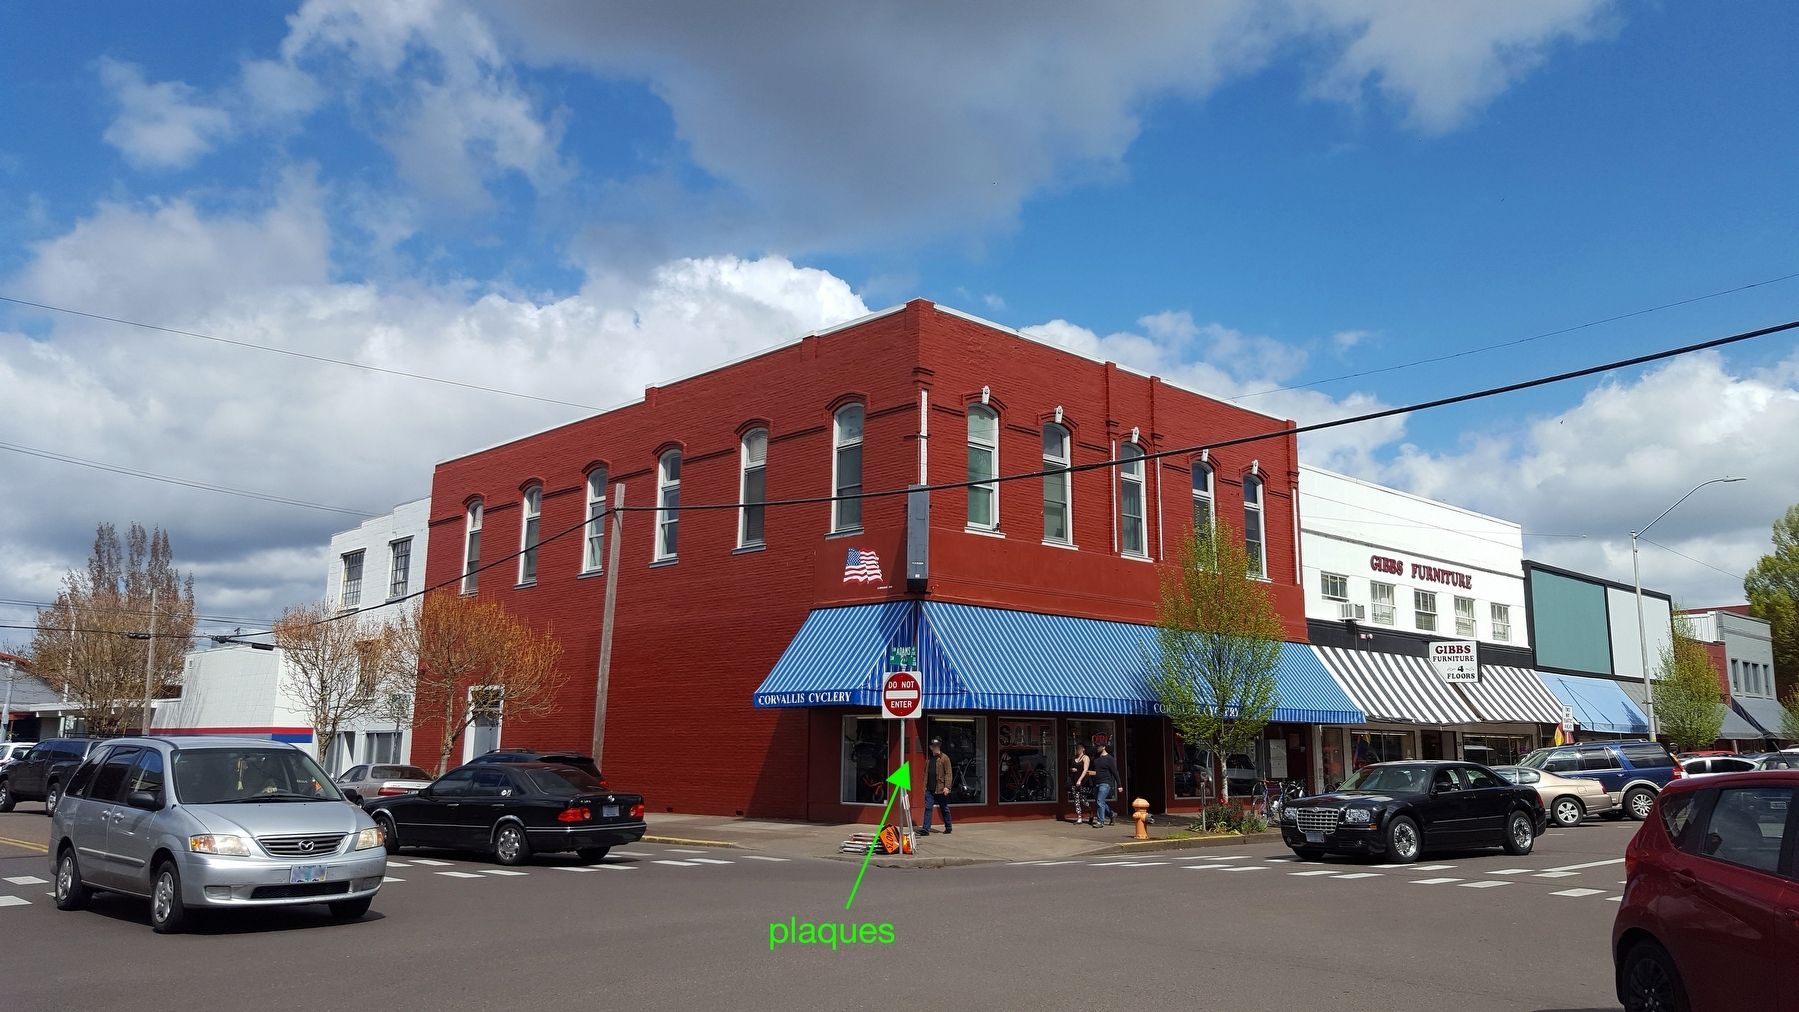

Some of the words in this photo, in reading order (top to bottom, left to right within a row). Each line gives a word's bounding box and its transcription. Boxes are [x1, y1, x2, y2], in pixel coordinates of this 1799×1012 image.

[1370, 555, 1404, 576] GIBBS
[1411, 563, 1473, 590] FURNITURE
[1435, 645, 1472, 654] GIBBS
[1457, 665, 1464, 673] 4
[1447, 672, 1476, 680] FLOORS
[888, 681, 898, 689] DO
[901, 681, 915, 689] NOT
[758, 693, 805, 705] CORVALLIS
[808, 691, 852, 703] CYCLERY
[890, 700, 912, 709] ENTER
